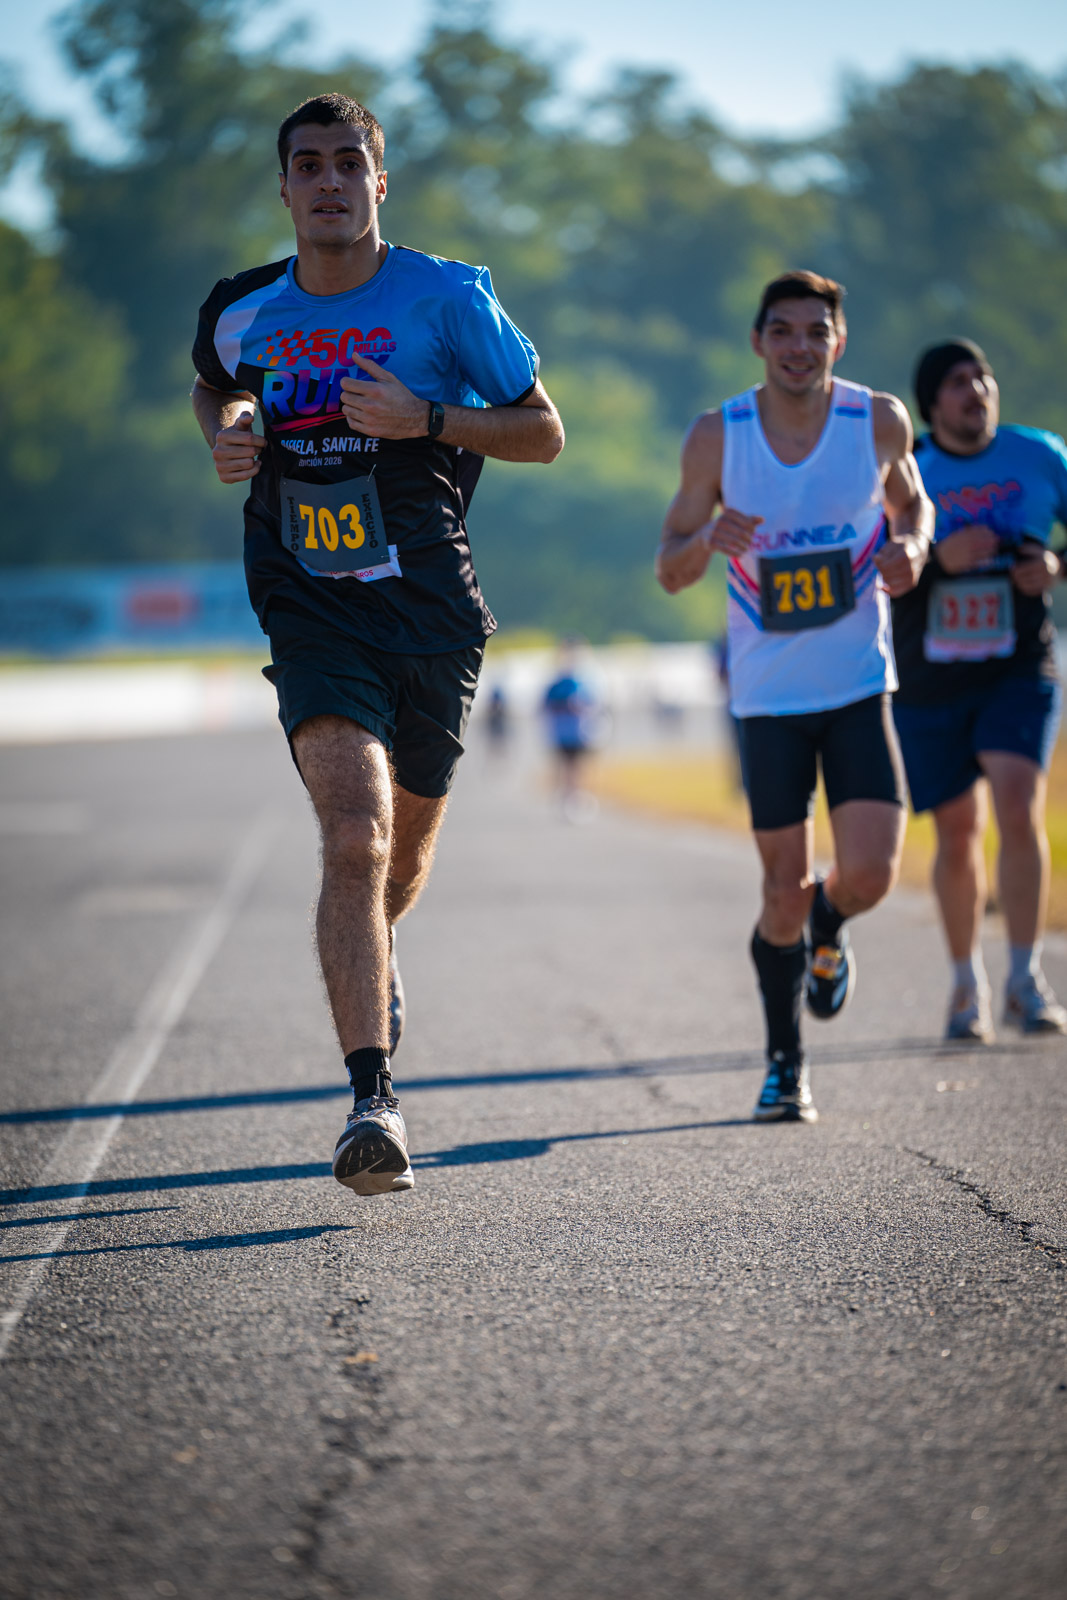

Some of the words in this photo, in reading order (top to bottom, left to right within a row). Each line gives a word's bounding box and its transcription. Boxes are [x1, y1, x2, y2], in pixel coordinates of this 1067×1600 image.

[353, 341, 398, 354] MILLAS
[322, 437, 361, 453] SANTA
[364, 437, 380, 453] FE
[323, 456, 342, 466] 2026
[287, 496, 300, 552] TIEMPO
[298, 503, 366, 552] 703
[360, 493, 379, 549] EXACTO
[750, 523, 856, 551] RUNNEA
[774, 565, 835, 613] 731
